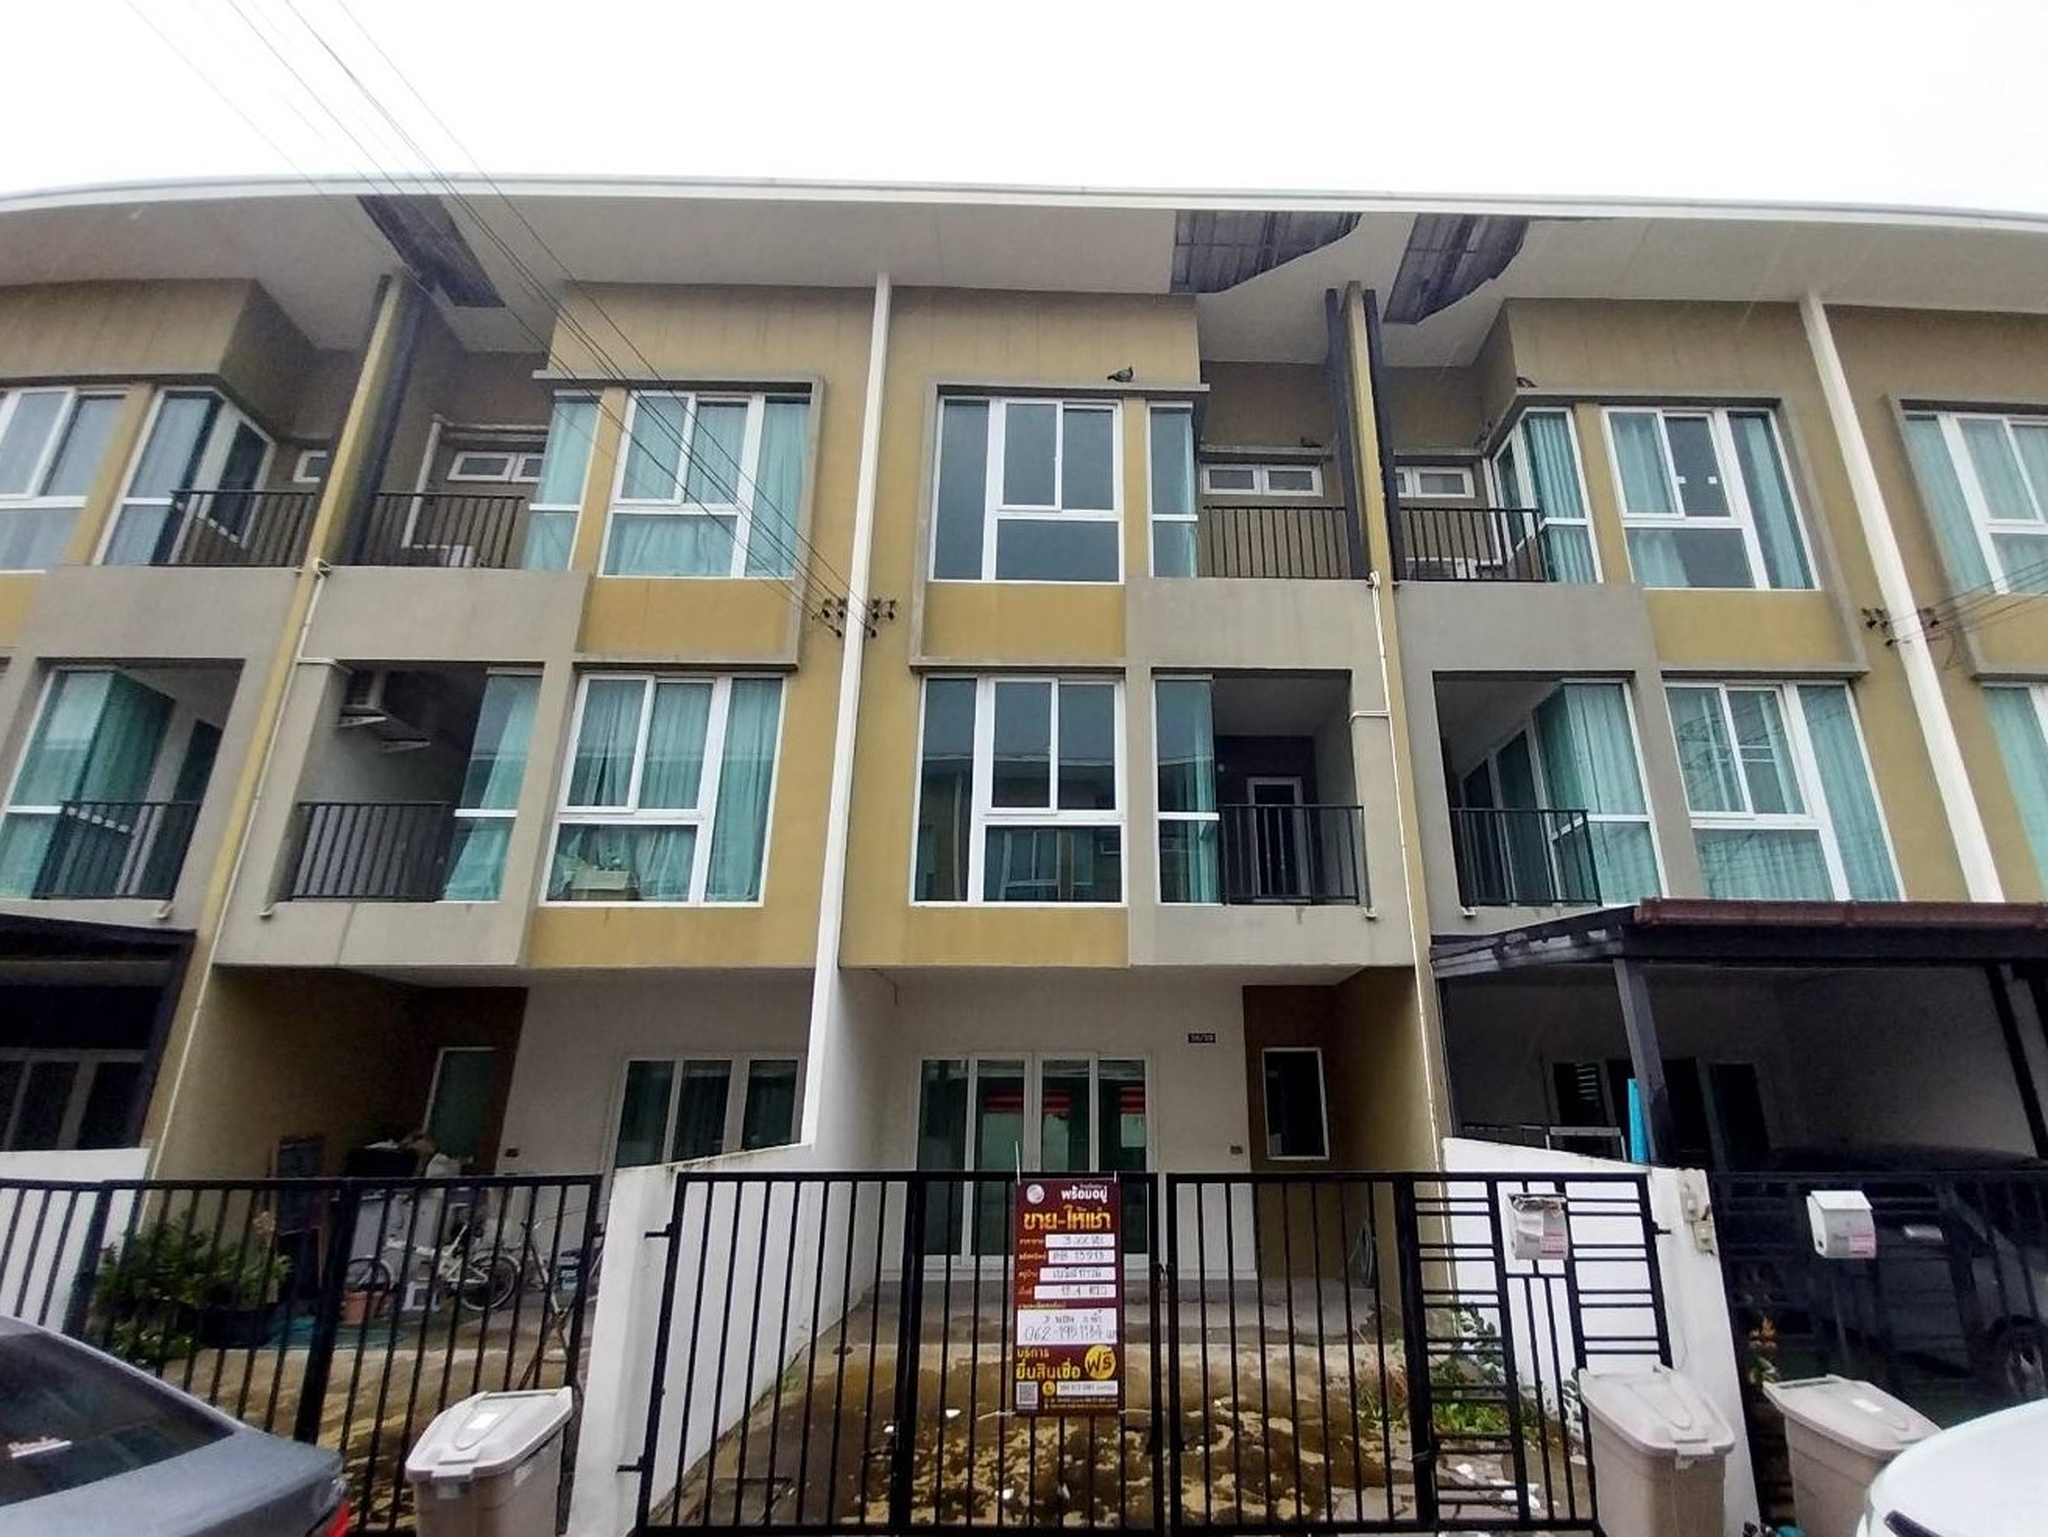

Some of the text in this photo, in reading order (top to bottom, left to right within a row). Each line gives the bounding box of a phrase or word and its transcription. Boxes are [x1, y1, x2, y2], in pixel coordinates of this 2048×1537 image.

[1061, 1185, 1108, 1204] พร้อมอยู่
[1087, 1347, 1113, 1374] ฟรี
